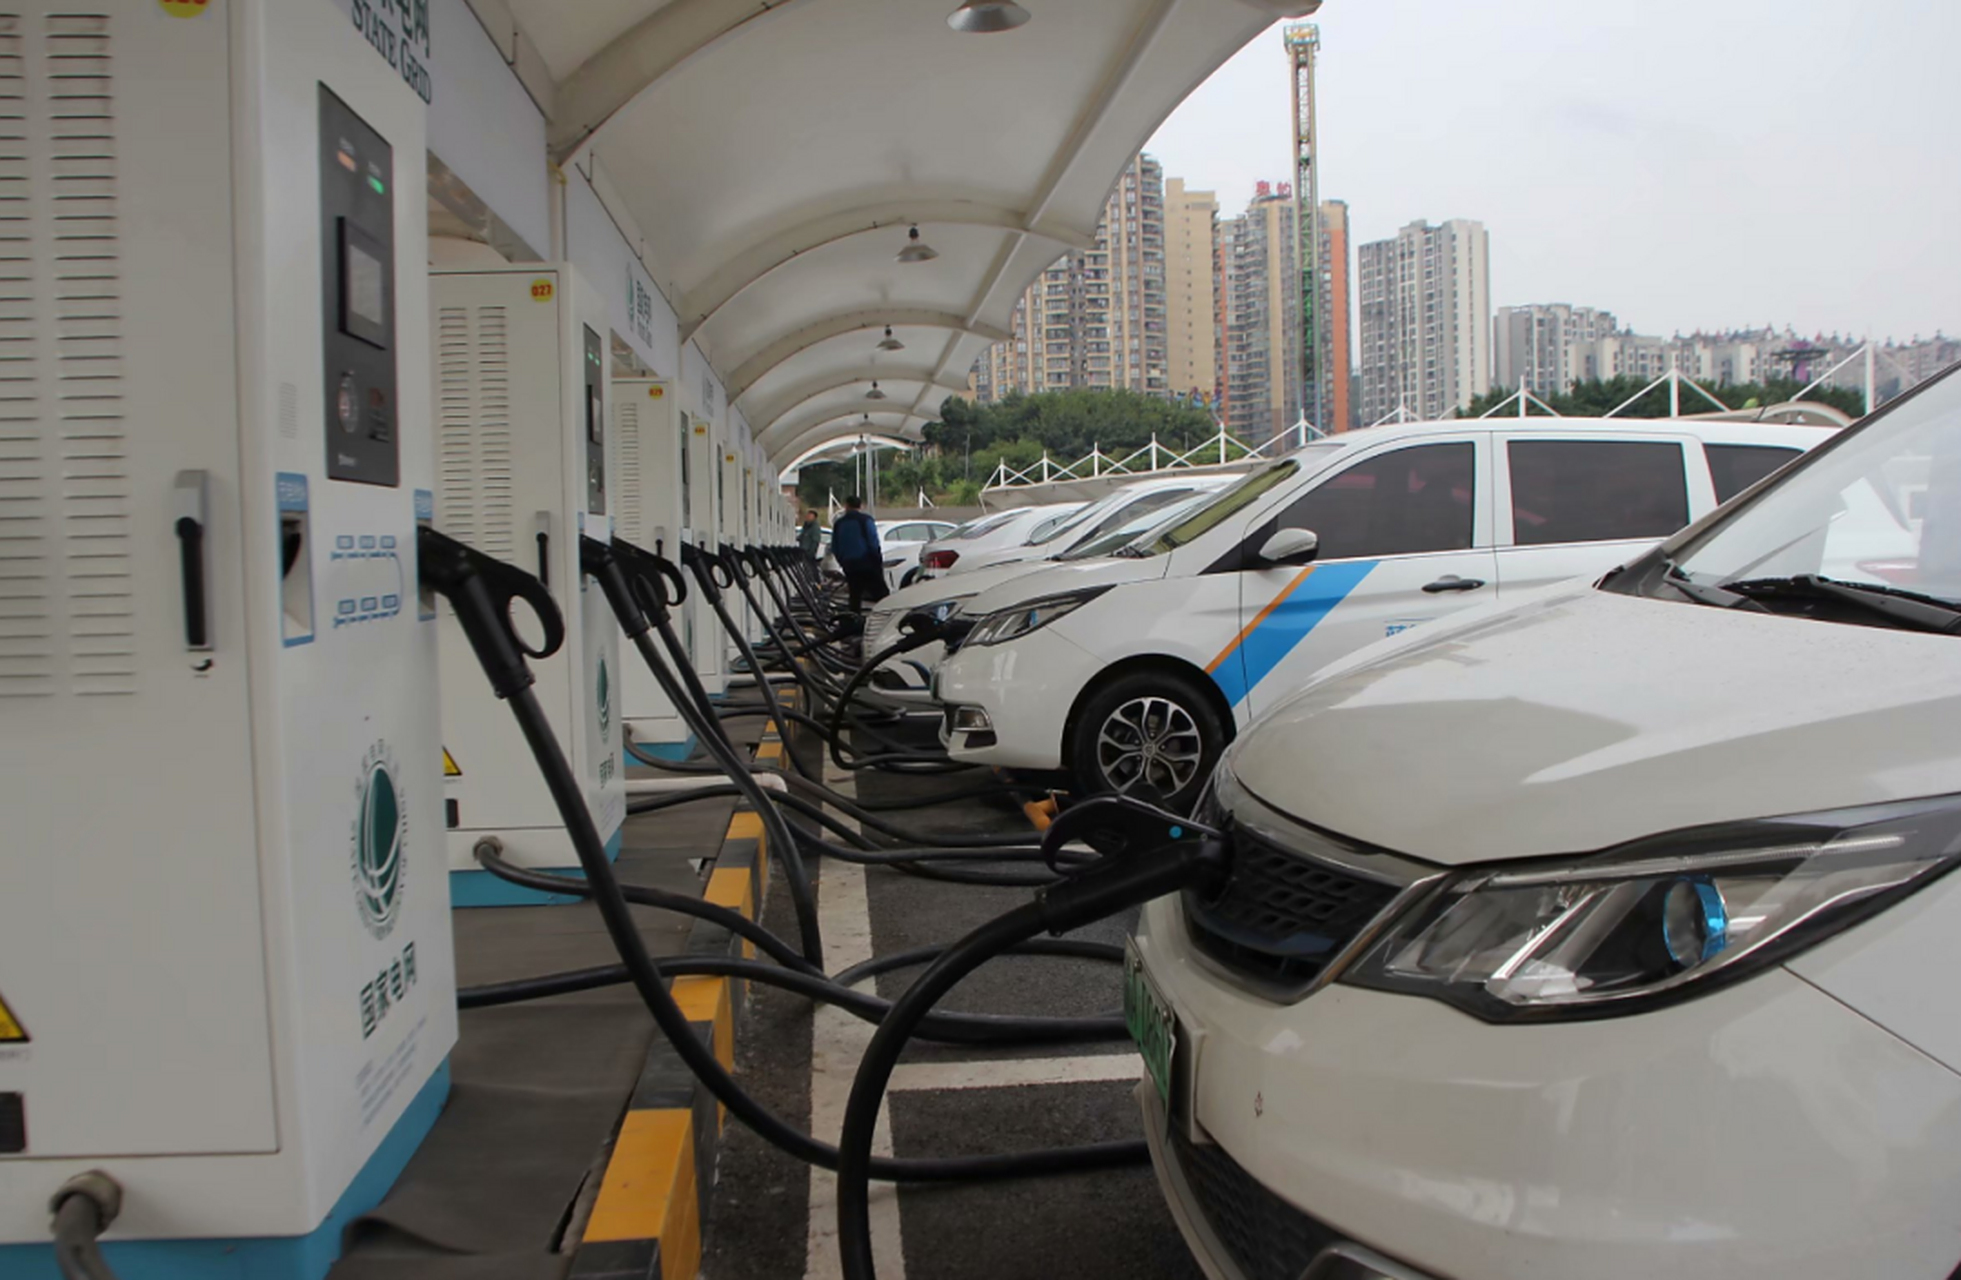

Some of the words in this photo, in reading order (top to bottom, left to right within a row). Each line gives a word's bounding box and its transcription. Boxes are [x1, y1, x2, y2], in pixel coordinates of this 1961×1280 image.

[351, 0, 397, 70] STATE
[400, 38, 432, 105] GRID
[531, 284, 552, 297] 027
